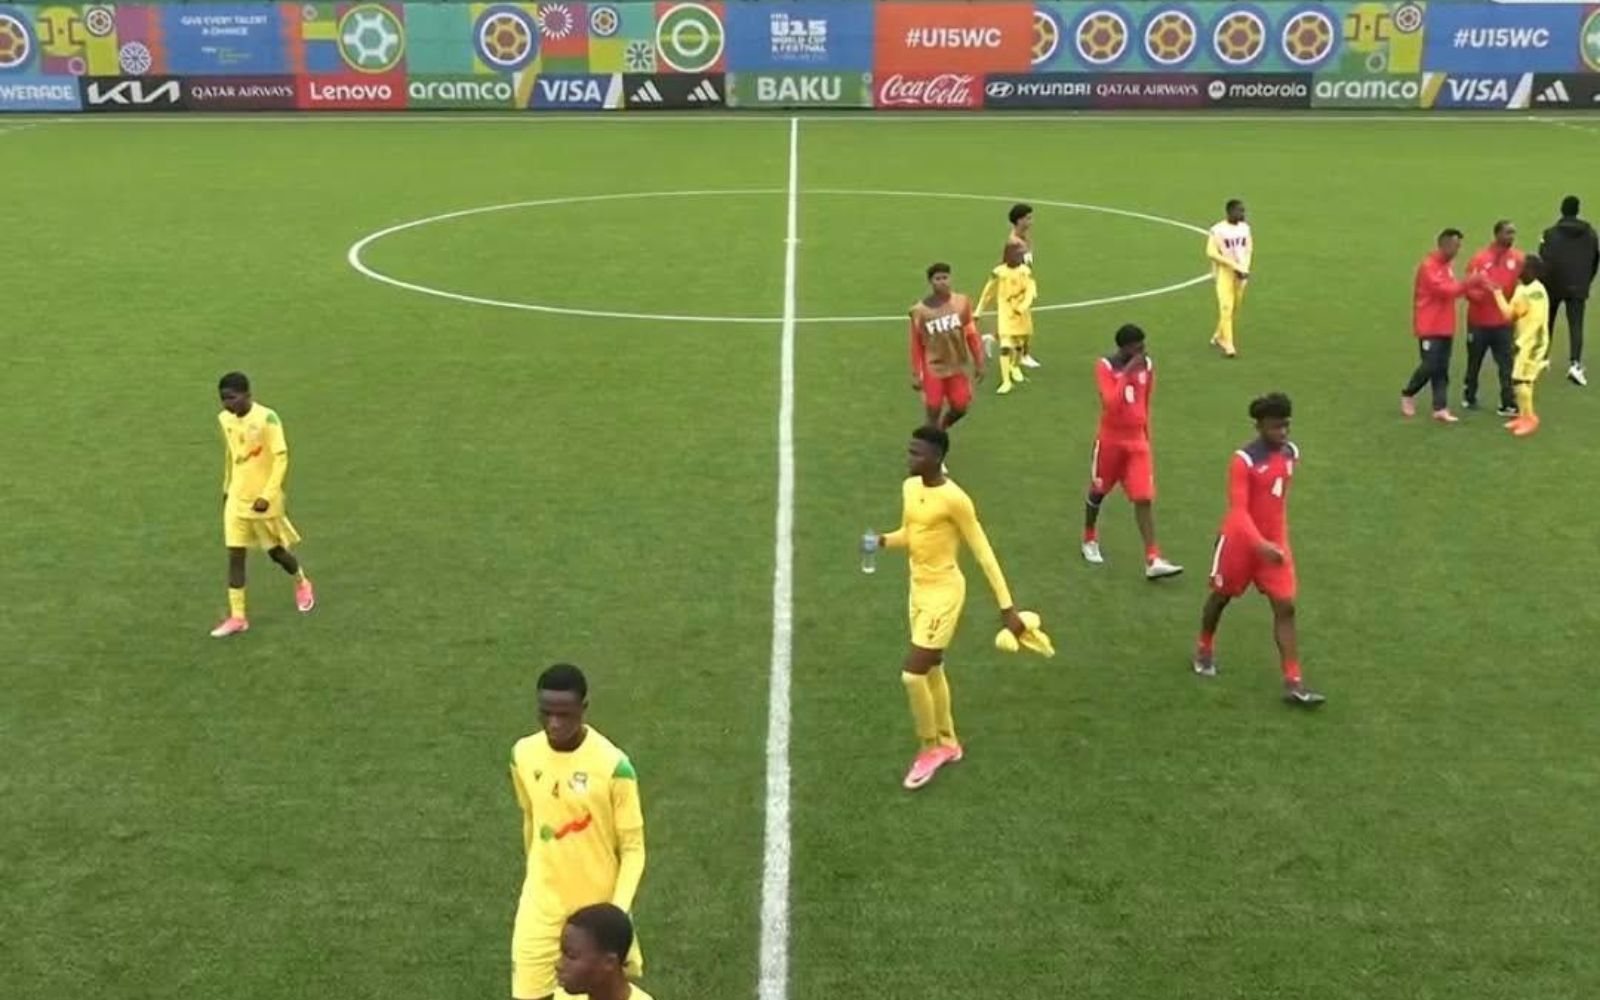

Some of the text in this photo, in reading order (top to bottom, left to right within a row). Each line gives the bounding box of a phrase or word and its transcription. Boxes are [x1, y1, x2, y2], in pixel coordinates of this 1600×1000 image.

[771, 20, 827, 36] U15
[905, 28, 1001, 48] #U15WC
[1453, 28, 1549, 48] #U15WC
[87, 80, 181, 104] KIA
[191, 86, 294, 99] QATAR AIRWAYS
[310, 82, 392, 100] Lenovo
[409, 81, 511, 99] aramco
[538, 80, 602, 101] VISA
[757, 77, 841, 101] BAKU
[1017, 83, 1090, 96] HYUNDAI
[1096, 84, 1199, 96] QATAR AIRWAYS
[1229, 82, 1307, 97] motorola
[1315, 81, 1419, 99] aramco
[1447, 79, 1509, 101] VISA
[925, 313, 961, 335] FIFA
[1272, 477, 1283, 497] 4
